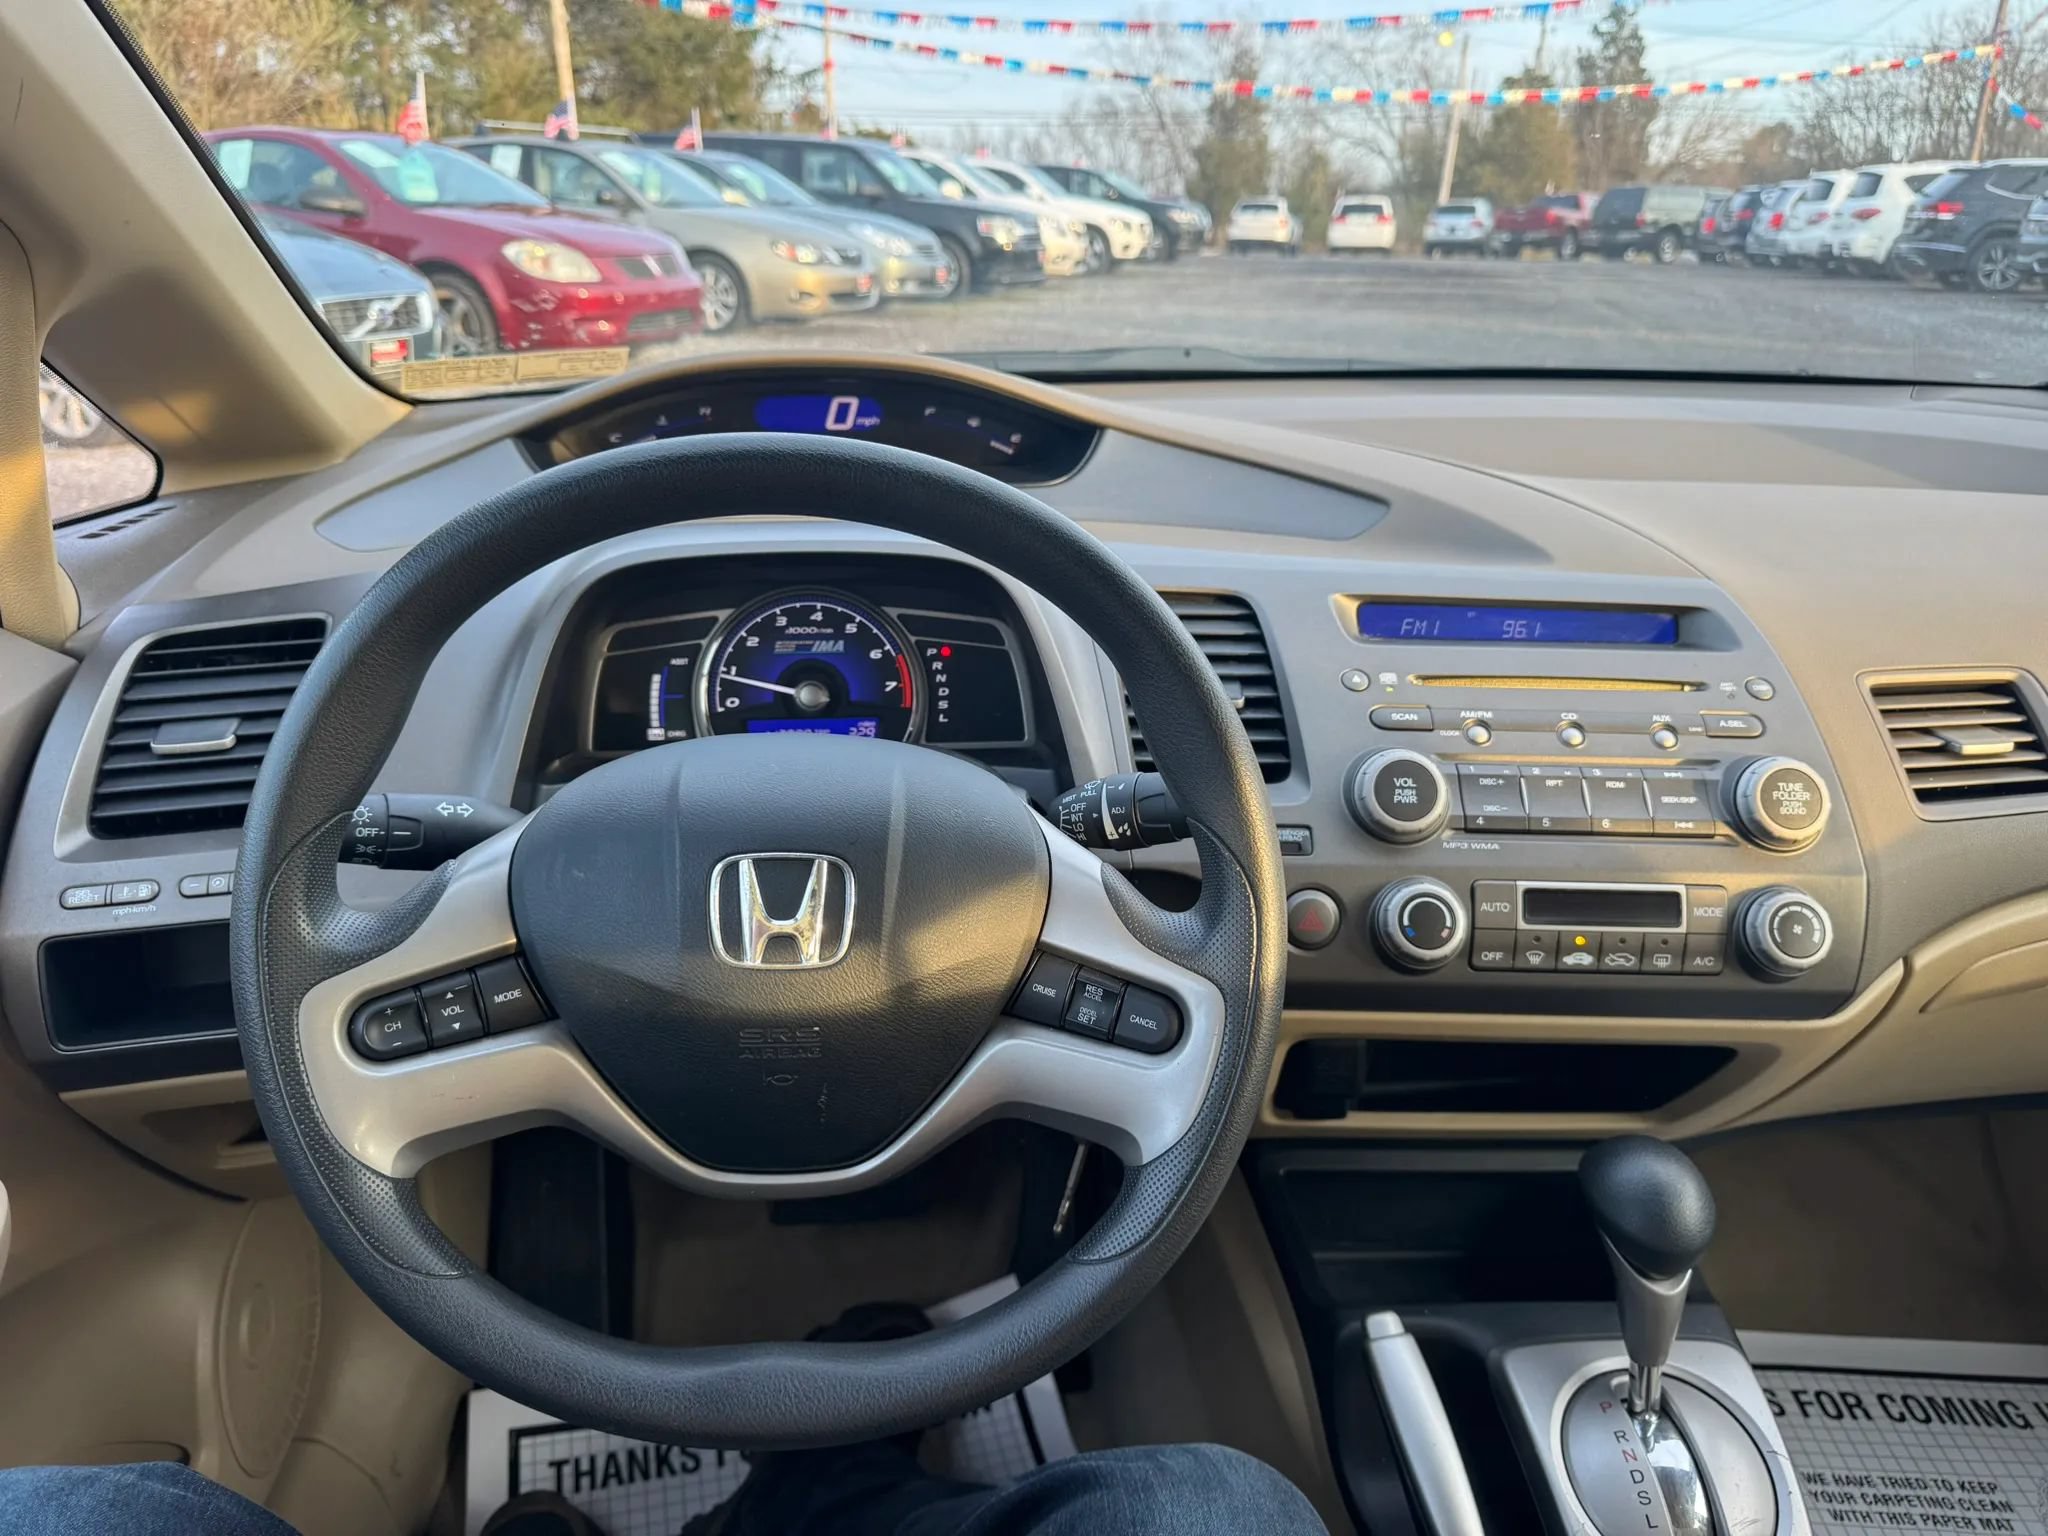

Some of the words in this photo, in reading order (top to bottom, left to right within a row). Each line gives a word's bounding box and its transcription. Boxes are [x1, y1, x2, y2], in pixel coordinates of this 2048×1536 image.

[825, 396, 860, 431] 0
[856, 416, 881, 427] mph
[809, 611, 823, 621] 4
[775, 616, 788, 627] 3
[844, 623, 858, 634] 5
[746, 636, 760, 647] 2
[869, 649, 882, 659] 6
[927, 648, 937, 656] P
[730, 665, 737, 676] 1
[932, 662, 943, 670] R
[936, 674, 947, 682] N
[884, 681, 898, 691] 7
[938, 687, 949, 696] D
[725, 697, 740, 708] 0
[938, 700, 949, 709] S
[939, 713, 949, 722] L
[1391, 713, 1418, 721] SCAN
[1561, 712, 1578, 720] CD
[1393, 778, 1417, 787] VOL
[1777, 783, 1803, 792] TUNE
[1394, 796, 1418, 804] PWR
[1772, 791, 1810, 800] FOLDER
[1071, 802, 1086, 812] OFF
[1111, 806, 1125, 814] ADJ
[1071, 813, 1083, 822] INT
[1476, 816, 1485, 825] 4
[1542, 818, 1550, 827] 5
[1073, 822, 1084, 832] LO
[1602, 819, 1610, 828] 6
[356, 827, 379, 837] OFF
[1442, 841, 1468, 850] MP3
[1471, 842, 1500, 850] WMA
[1480, 902, 1509, 912] AUTO
[1693, 907, 1723, 917] MODE
[1481, 951, 1503, 961] OFF
[1693, 956, 1715, 966] A/C
[1032, 983, 1057, 998] CRUISE
[1085, 984, 1103, 996] RES
[494, 989, 523, 1003] MODE
[1083, 992, 1103, 1002] ACCEL
[441, 1004, 465, 1017] VOL
[1079, 1006, 1098, 1017] DECEL
[1077, 1013, 1096, 1025] SET
[1129, 1014, 1158, 1030] CANCEL
[384, 1021, 402, 1033] CH
[739, 1027, 822, 1043] SRS
[1599, 1402, 1612, 1415] P
[1791, 1389, 1873, 1421] FOR
[1876, 1393, 2034, 1430] COMING
[1614, 1430, 1630, 1444] R
[1623, 1449, 1637, 1463] N
[549, 1445, 700, 1493] THANKS
[1630, 1470, 1644, 1484] D
[1801, 1472, 1831, 1486] WE
[1832, 1475, 1874, 1488] HAVE
[1876, 1476, 1928, 1491] TRIED
[1930, 1478, 1954, 1492] TO
[1956, 1480, 1998, 1495] KEEP
[1637, 1490, 1651, 1505] S
[1809, 1490, 1858, 1505] YOUR
[1860, 1493, 1956, 1511] CARPETING
[1958, 1497, 2015, 1513] CLEAN
[1645, 1514, 1659, 1529] L
[1826, 1508, 1874, 1524] WITH
[1878, 1511, 1917, 1526] THIS
[1919, 1514, 1978, 1530] PAPER
[1978, 1517, 2016, 1532] MAT
